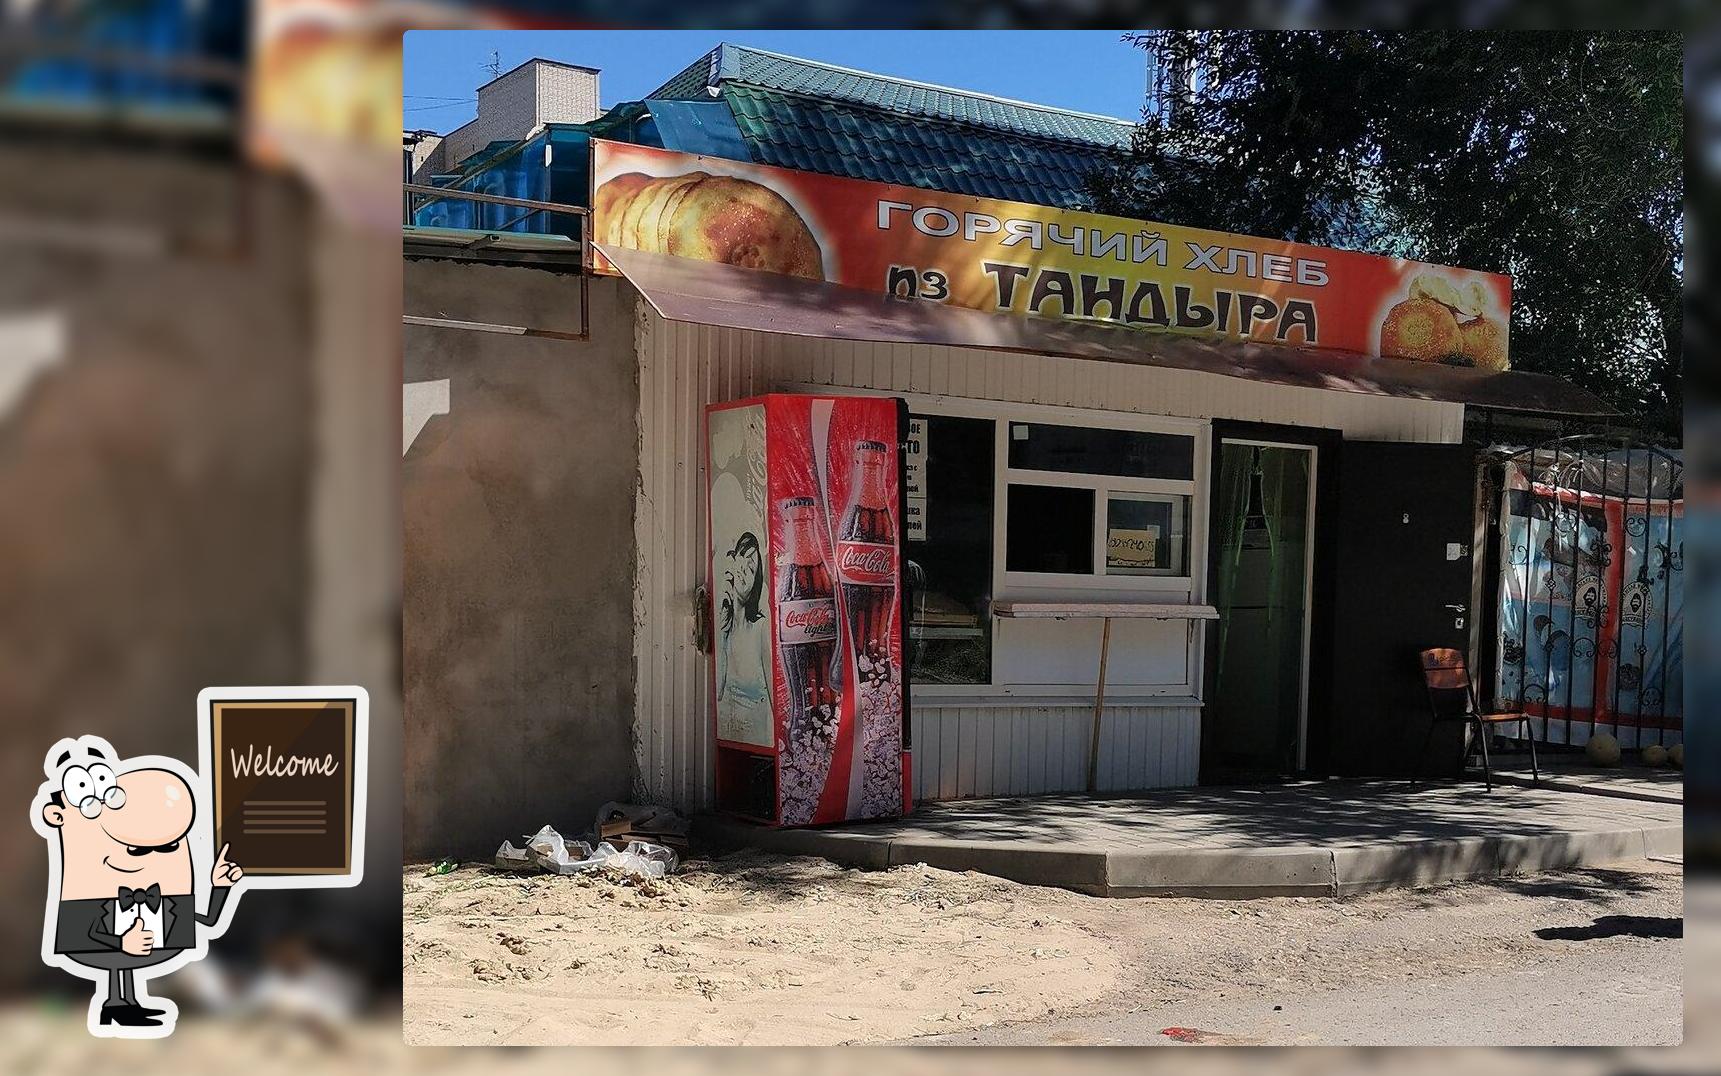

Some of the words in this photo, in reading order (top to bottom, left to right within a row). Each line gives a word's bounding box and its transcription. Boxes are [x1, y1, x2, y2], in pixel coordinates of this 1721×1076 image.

[877, 199, 1168, 267] ГОРЯЧИЙ
[1184, 241, 1330, 287] ХЛЕБ
[983, 262, 1320, 344] ТАНДЫРА
[841, 546, 895, 577] Coca-Cola
